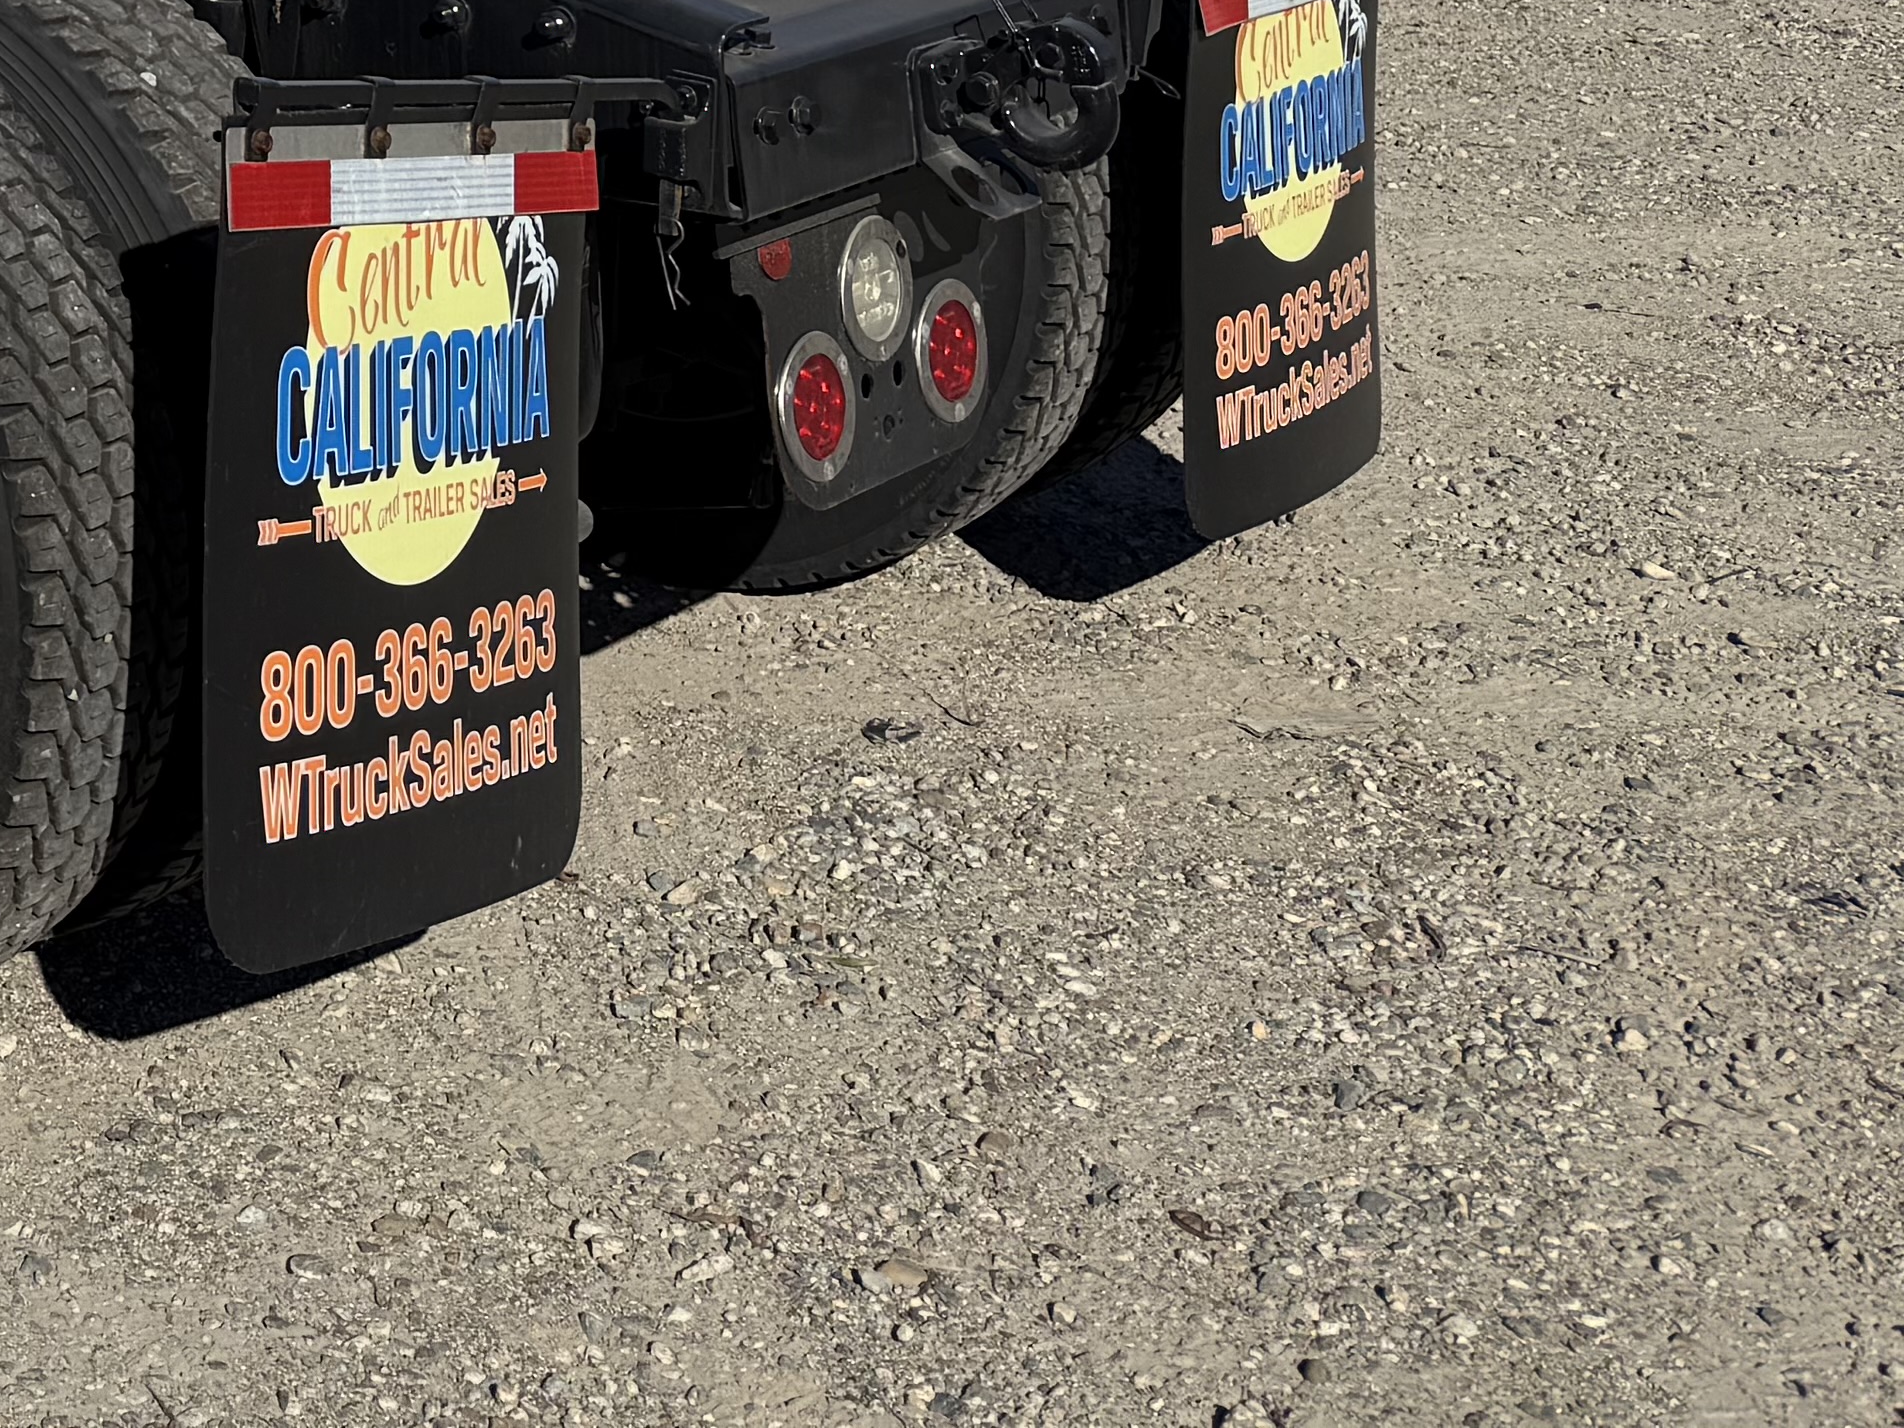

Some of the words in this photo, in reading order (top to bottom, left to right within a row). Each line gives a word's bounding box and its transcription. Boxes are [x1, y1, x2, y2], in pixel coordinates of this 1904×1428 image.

[1220, 56, 1366, 202] CALIFORNIA
[1242, 204, 1276, 240] TRUCK
[1291, 183, 1326, 220] TRAILER
[1216, 250, 1370, 380] 800-366-3263
[277, 315, 551, 486] CALIFORNIA
[1216, 323, 1373, 450] WTruckSales.net
[312, 499, 373, 544] TRUCK
[377, 482, 401, 531] and
[403, 488, 465, 525] TRAILER
[469, 469, 517, 511] SALES
[260, 588, 558, 743] 800-366-3263
[258, 691, 559, 844] WTruckSales.net
